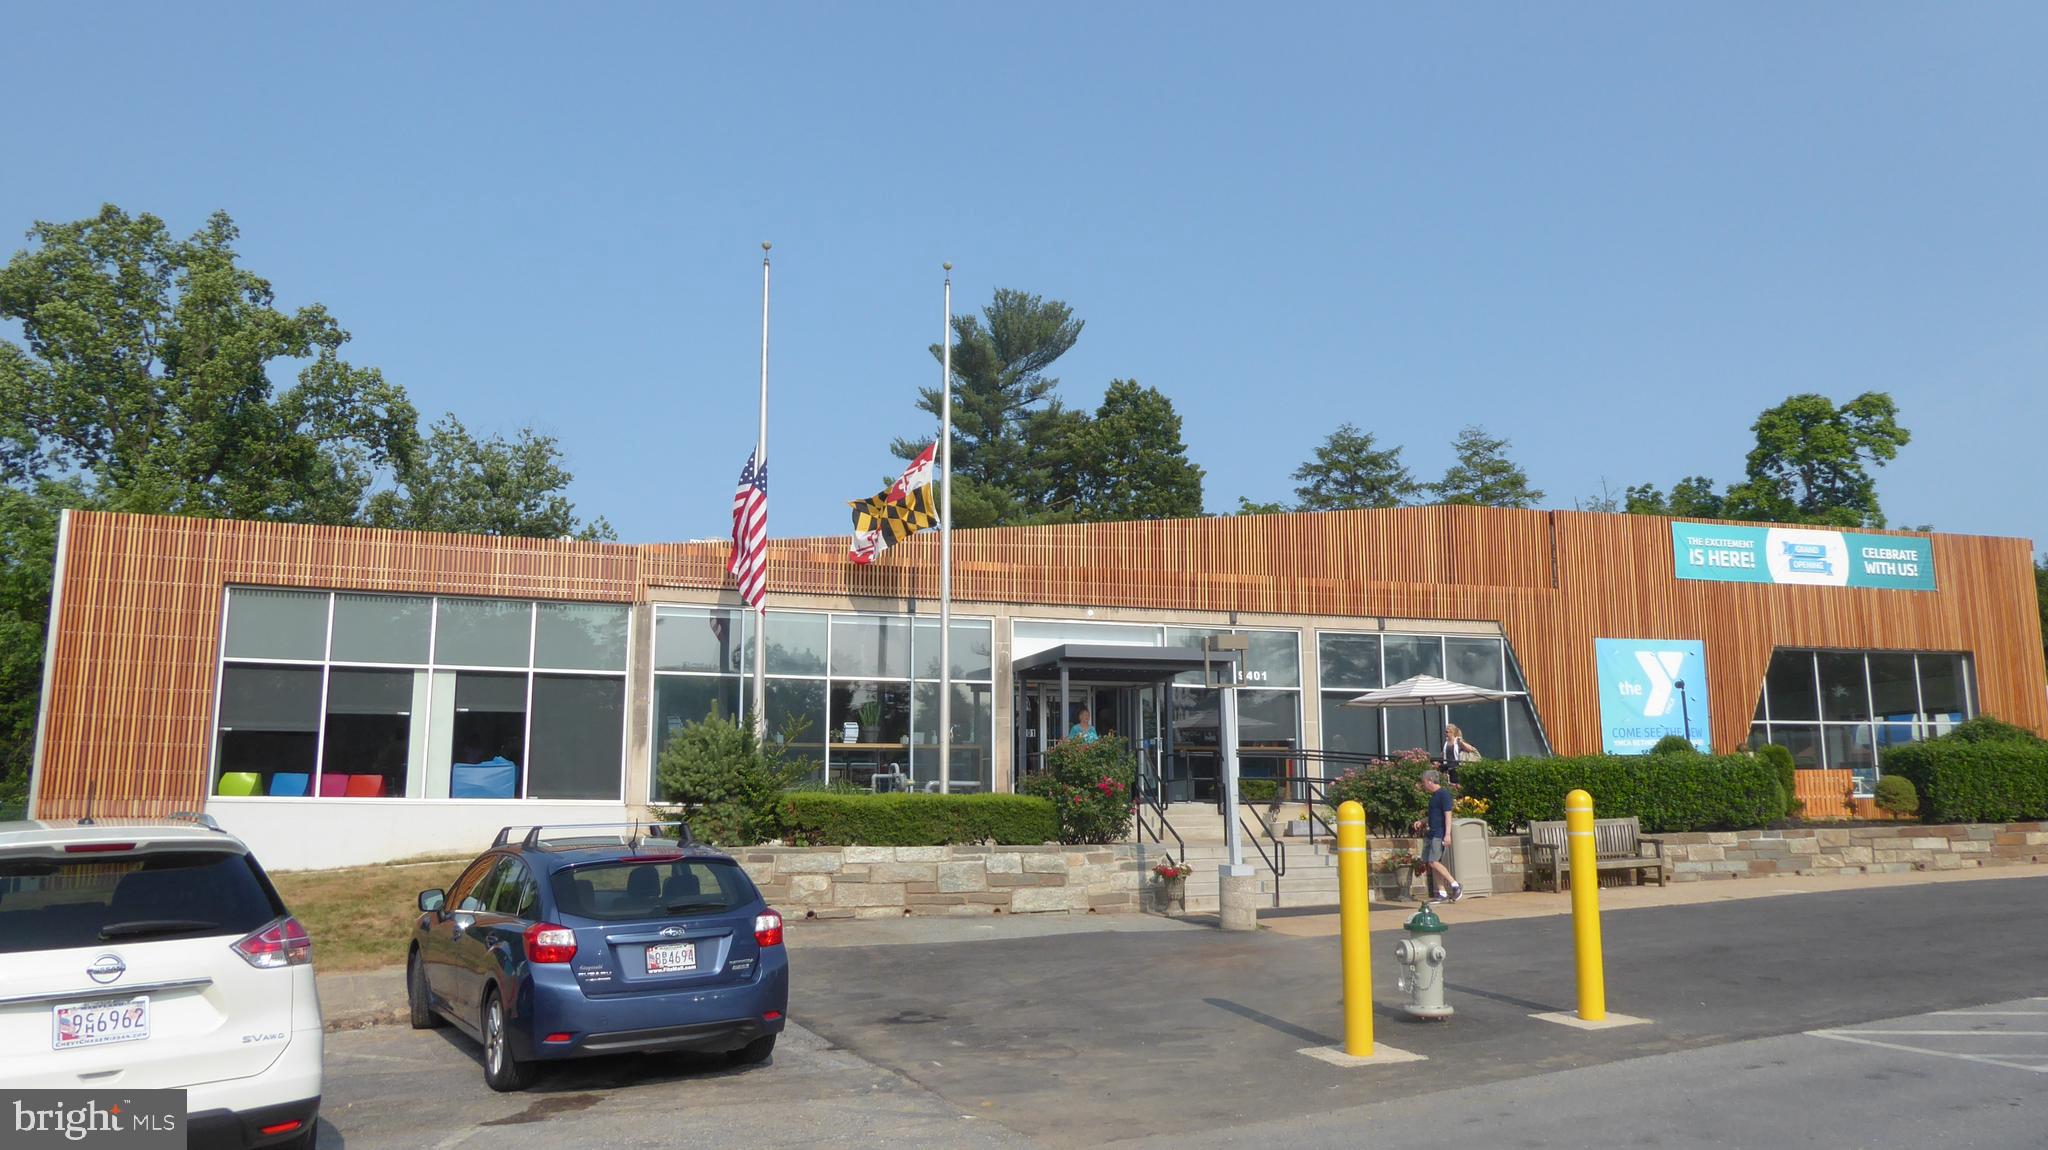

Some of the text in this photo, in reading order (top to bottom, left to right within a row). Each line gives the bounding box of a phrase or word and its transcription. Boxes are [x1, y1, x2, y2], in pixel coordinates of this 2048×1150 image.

[1687, 536, 1755, 549] THE EXCITEMENT
[1689, 548, 1756, 569] IS HERE!
[1862, 547, 1918, 561] CELEBRATE
[1864, 560, 1919, 577] WITH US!
[1618, 681, 1642, 695] the
[1635, 651, 1684, 715] Y
[1612, 728, 1641, 738] COME
[1644, 727, 1663, 738] SEE
[242, 1033, 263, 1044] SV
